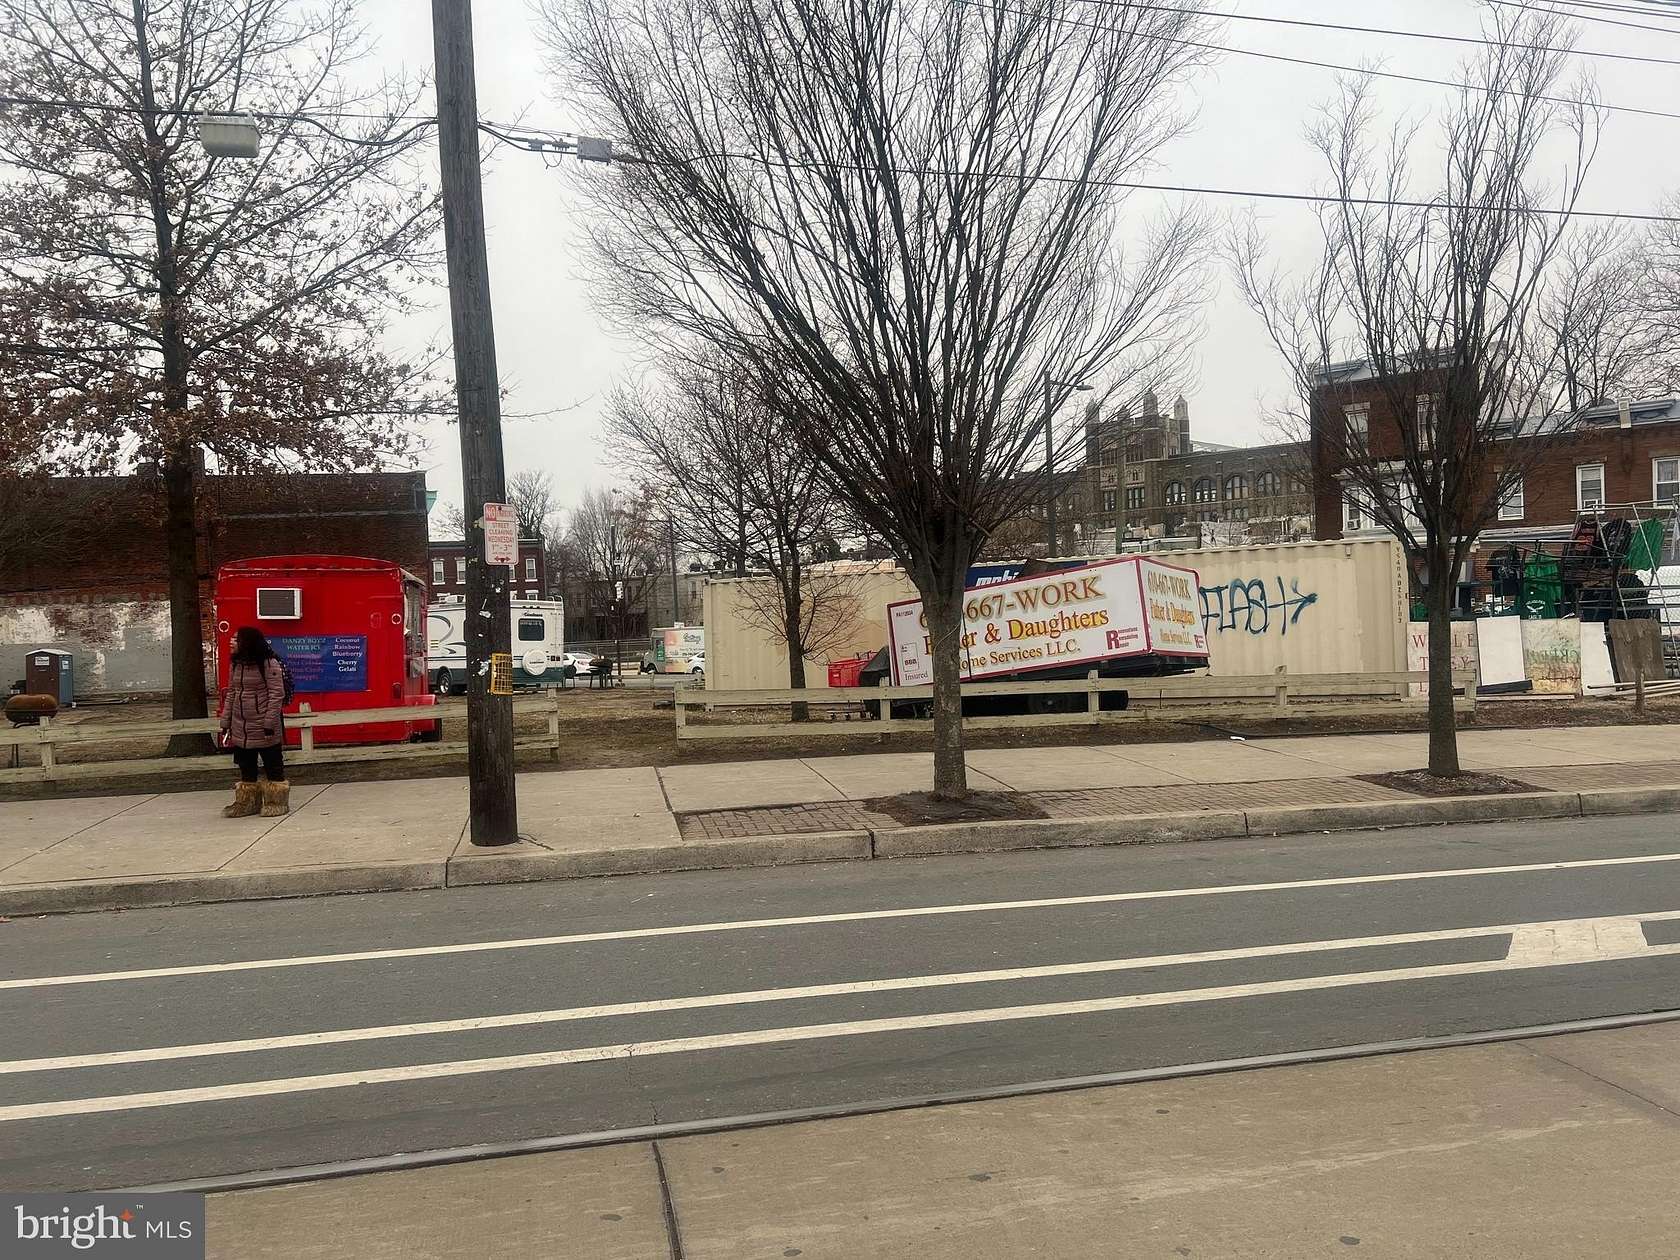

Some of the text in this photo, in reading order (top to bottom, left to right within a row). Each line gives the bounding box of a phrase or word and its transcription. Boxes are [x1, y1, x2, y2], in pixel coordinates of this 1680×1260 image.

[486, 506, 496, 520] NO
[984, 622, 1002, 644] &
[1006, 608, 1109, 641] Daughters
[989, 646, 1043, 665] Services
[1046, 637, 1081, 656] LLC.
[905, 670, 929, 681] Insured
